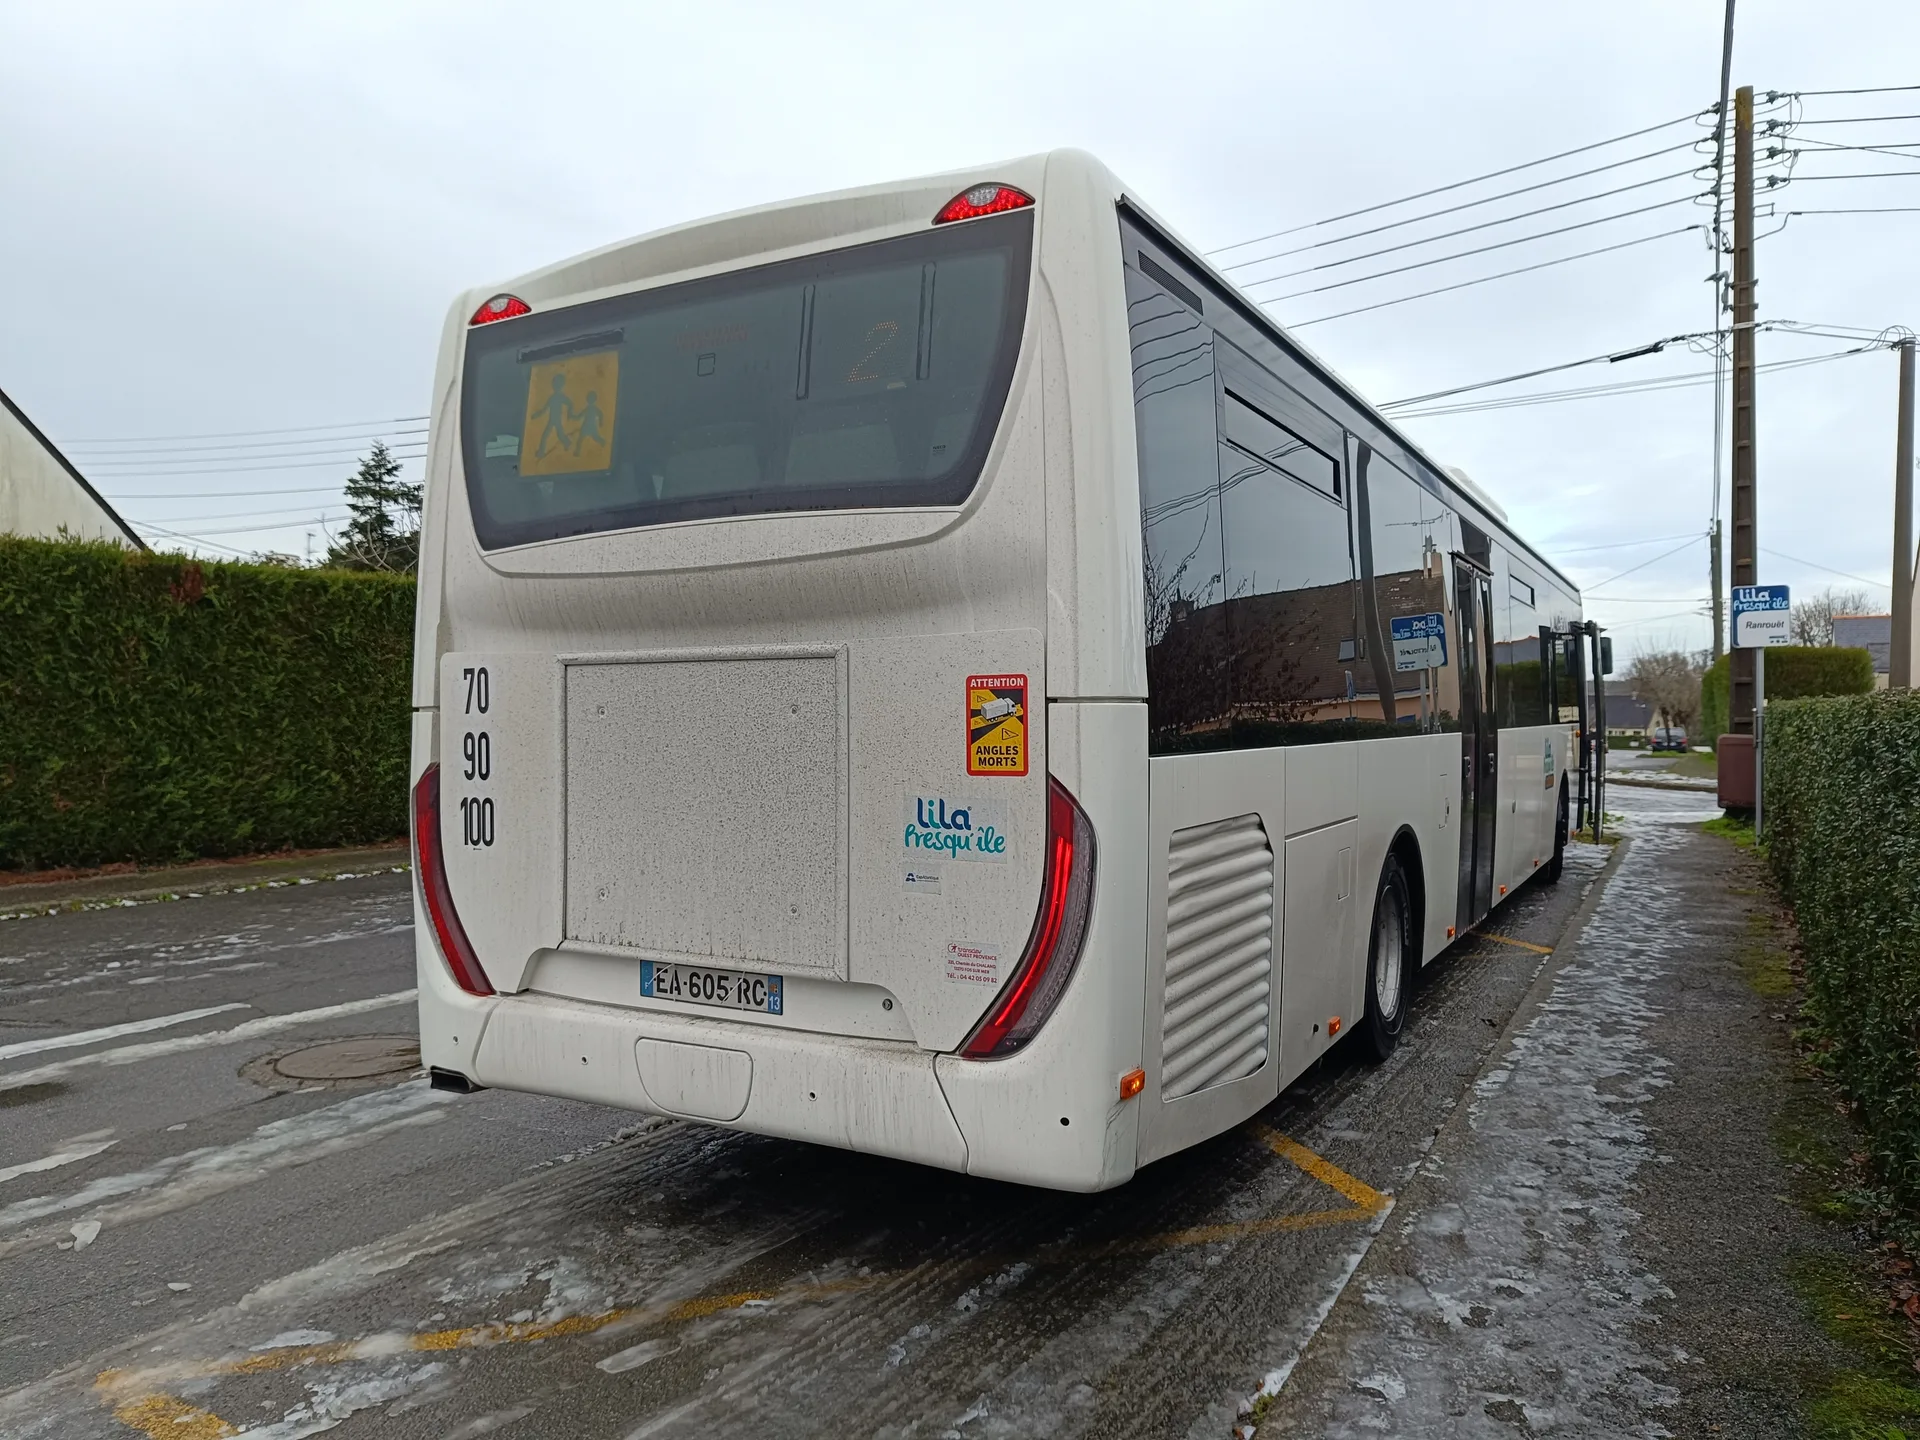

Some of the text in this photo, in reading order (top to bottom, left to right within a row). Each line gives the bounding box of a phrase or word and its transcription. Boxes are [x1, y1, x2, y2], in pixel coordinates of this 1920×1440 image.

[848, 320, 898, 382] 2
[463, 667, 490, 714] 70
[970, 678, 1024, 687] ATTENTION
[463, 731, 491, 781] 90
[976, 745, 1019, 756] ANGLES
[978, 756, 1017, 767] MORTS
[460, 797, 495, 847] 100
[768, 995, 781, 1011] 13
